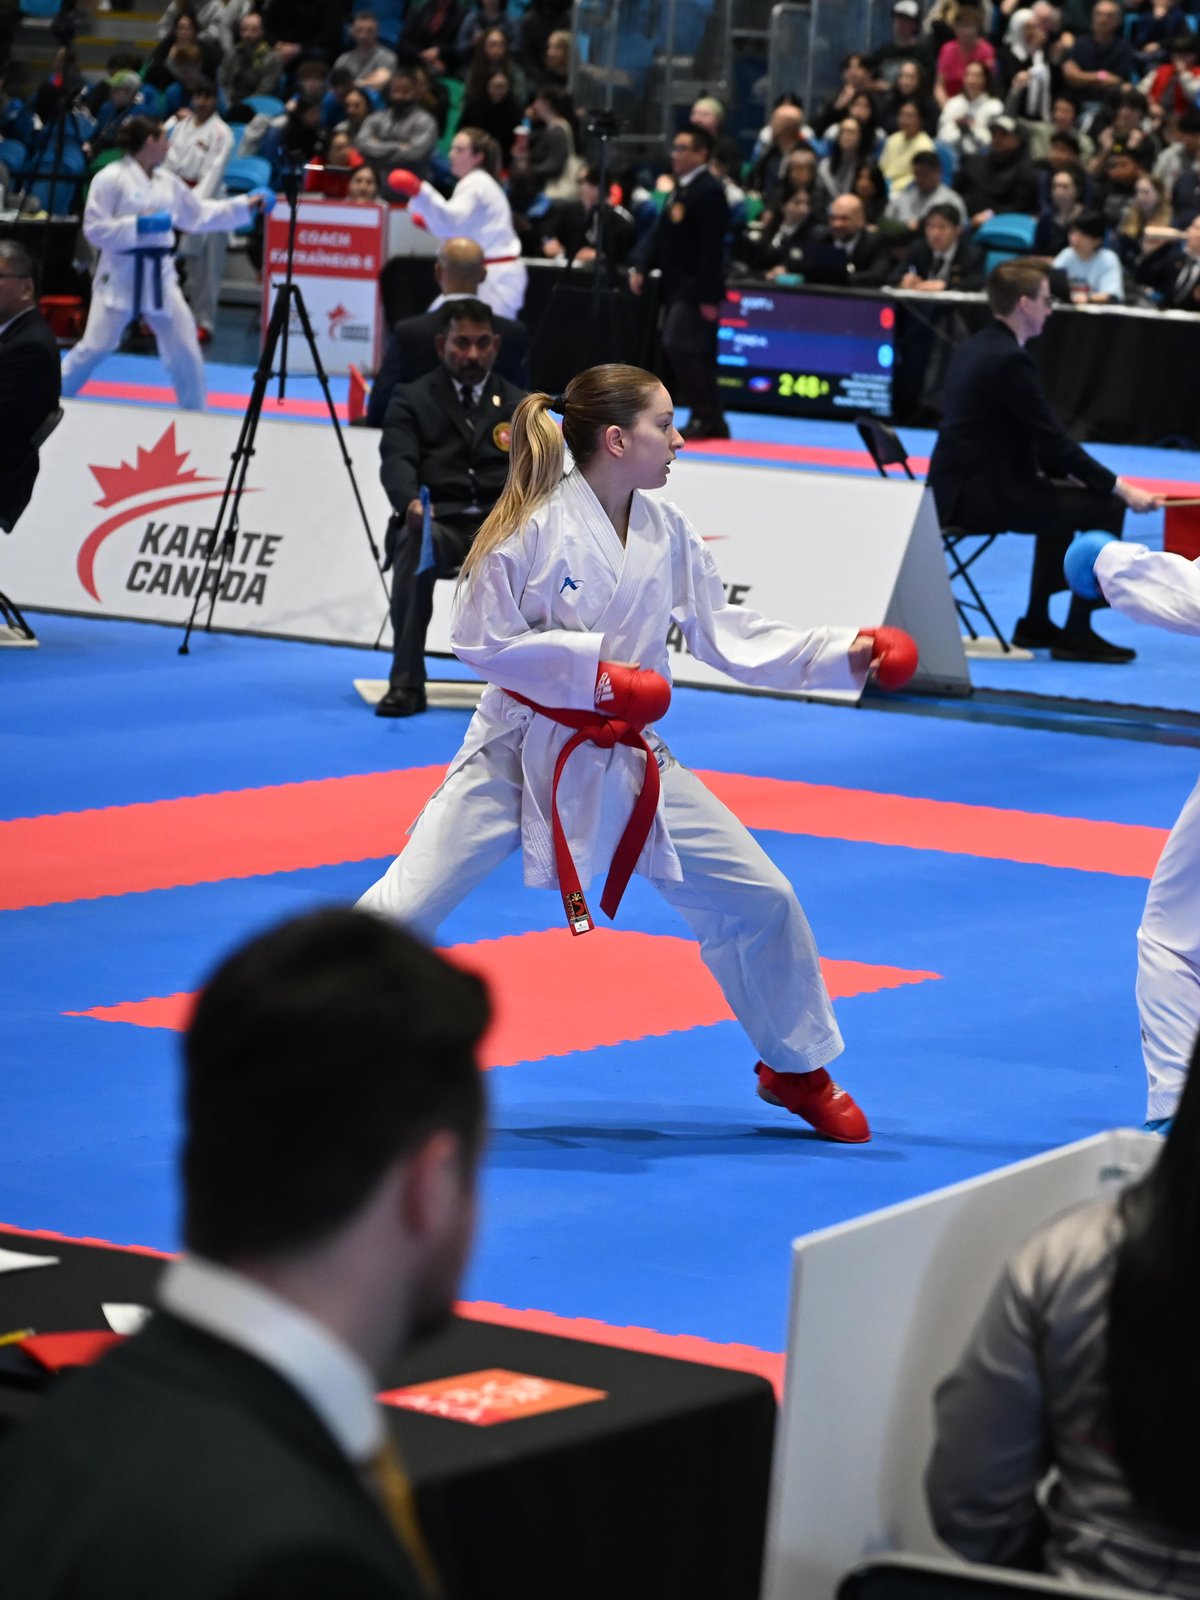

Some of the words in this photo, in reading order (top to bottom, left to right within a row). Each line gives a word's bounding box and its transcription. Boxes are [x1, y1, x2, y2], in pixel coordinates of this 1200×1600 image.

[298, 230, 351, 247] COACH
[138, 522, 283, 567] KARATE
[126, 560, 267, 605] CANADA
